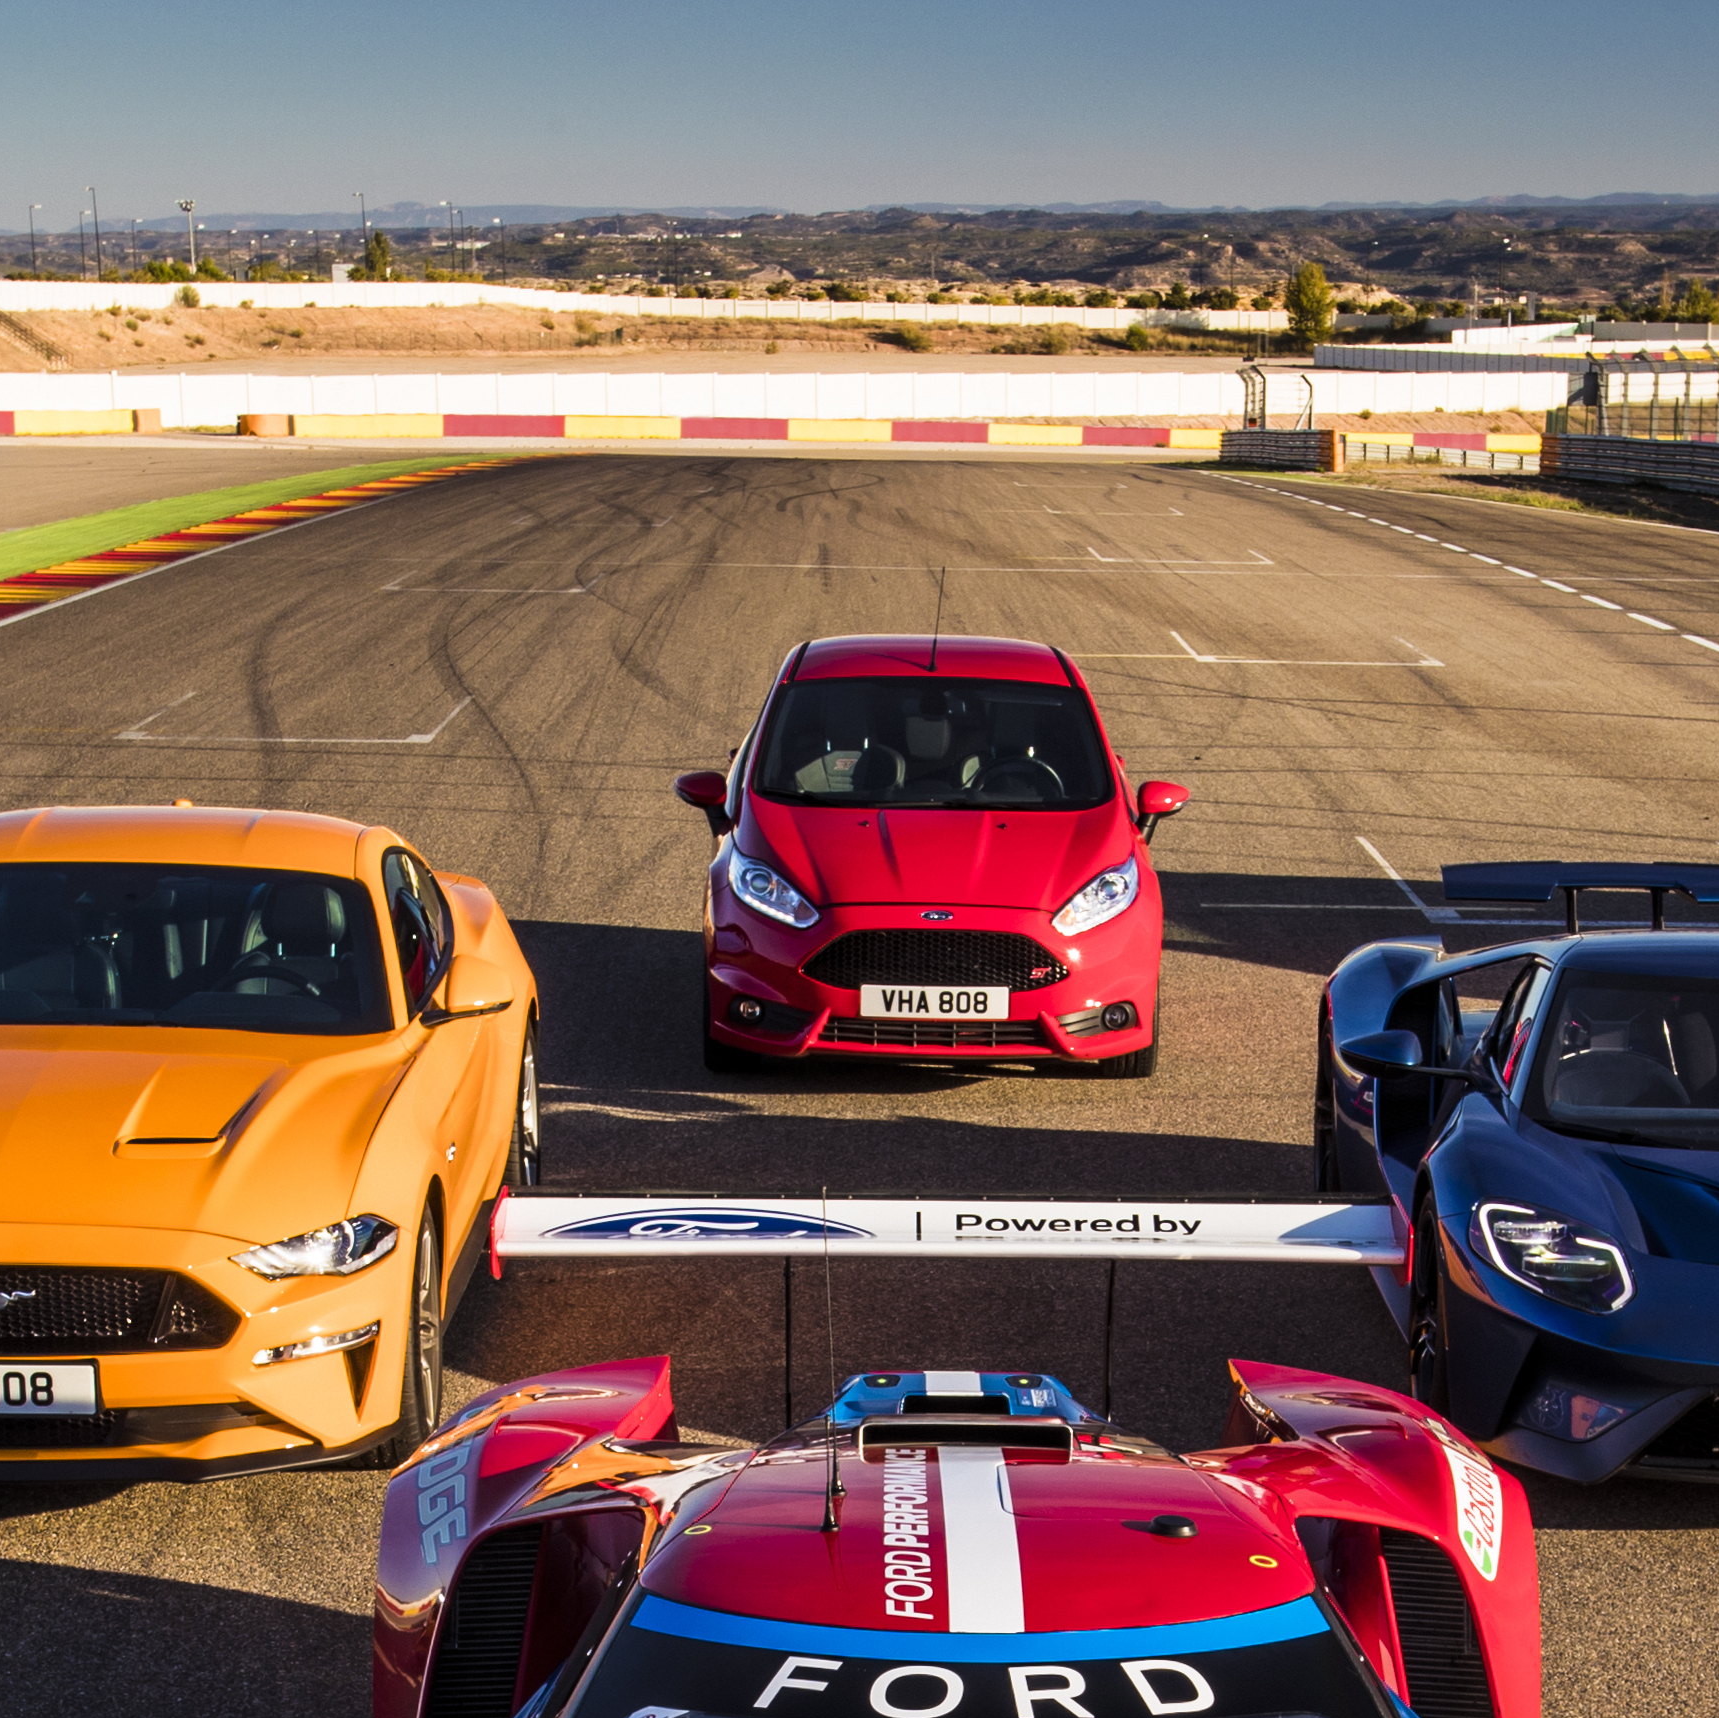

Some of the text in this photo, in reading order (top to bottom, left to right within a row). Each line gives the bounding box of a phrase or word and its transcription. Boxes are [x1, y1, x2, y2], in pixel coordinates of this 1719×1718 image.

[881, 989, 989, 1014] VHA 808
[955, 1213, 1202, 1235] Powered by
[883, 1448, 934, 1620] FORD PERFORMANCE
